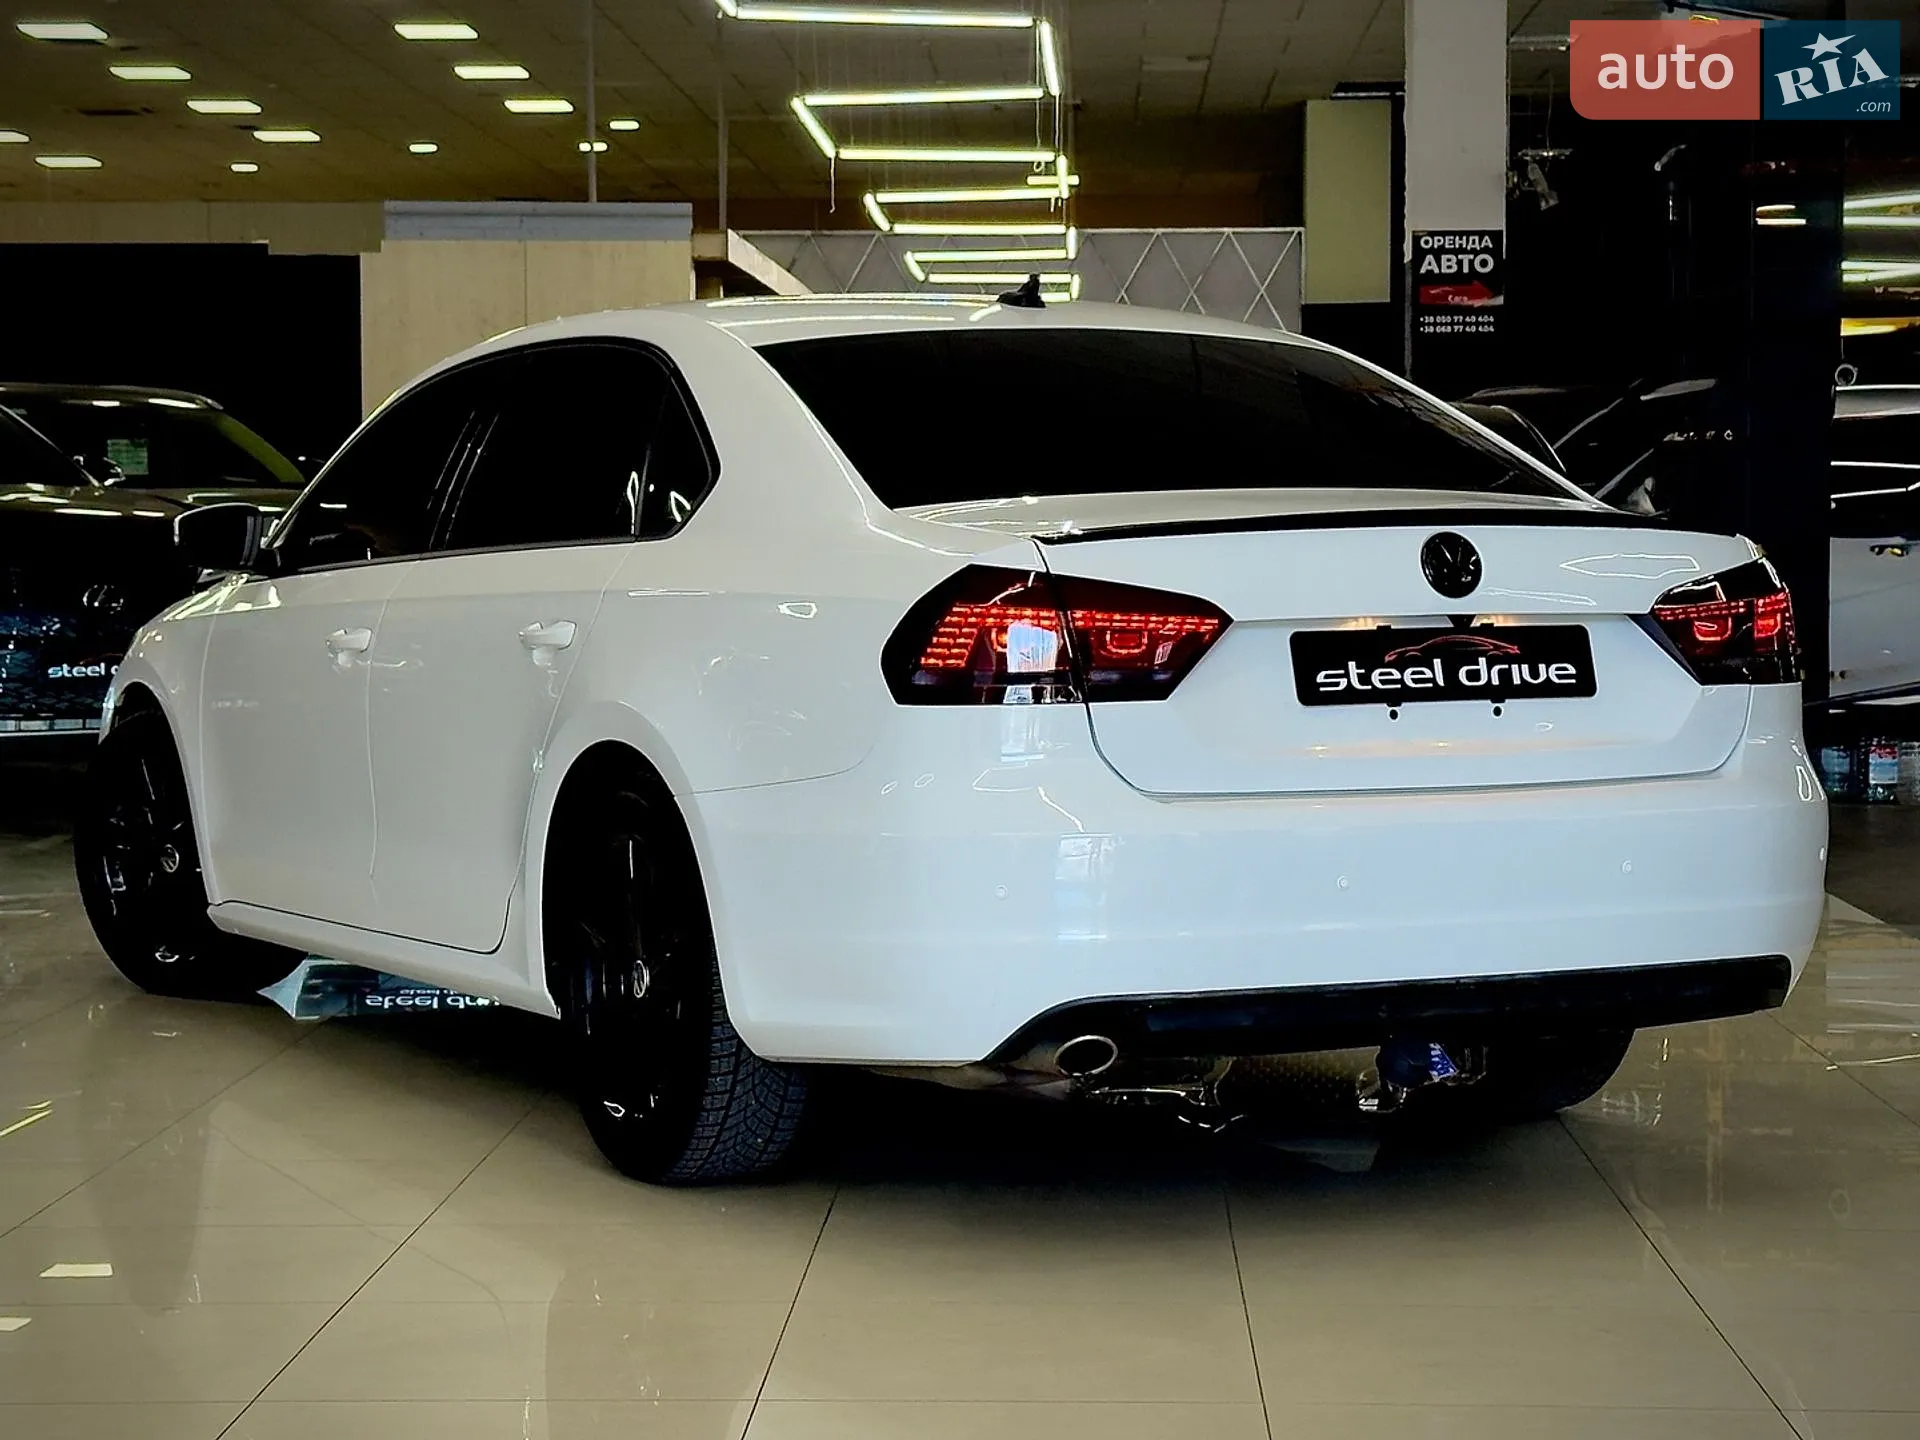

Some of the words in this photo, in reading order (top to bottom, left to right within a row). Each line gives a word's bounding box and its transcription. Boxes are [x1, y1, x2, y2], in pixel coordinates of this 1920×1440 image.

[1420, 235, 1493, 250] ОРЕНДА
[1419, 253, 1495, 274] АВТО
[1452, 315, 1464, 323] 77
[1452, 325, 1464, 333] 77
[47, 662, 106, 678] steel
[1316, 658, 1445, 692] steel
[1458, 657, 1577, 686] drive
